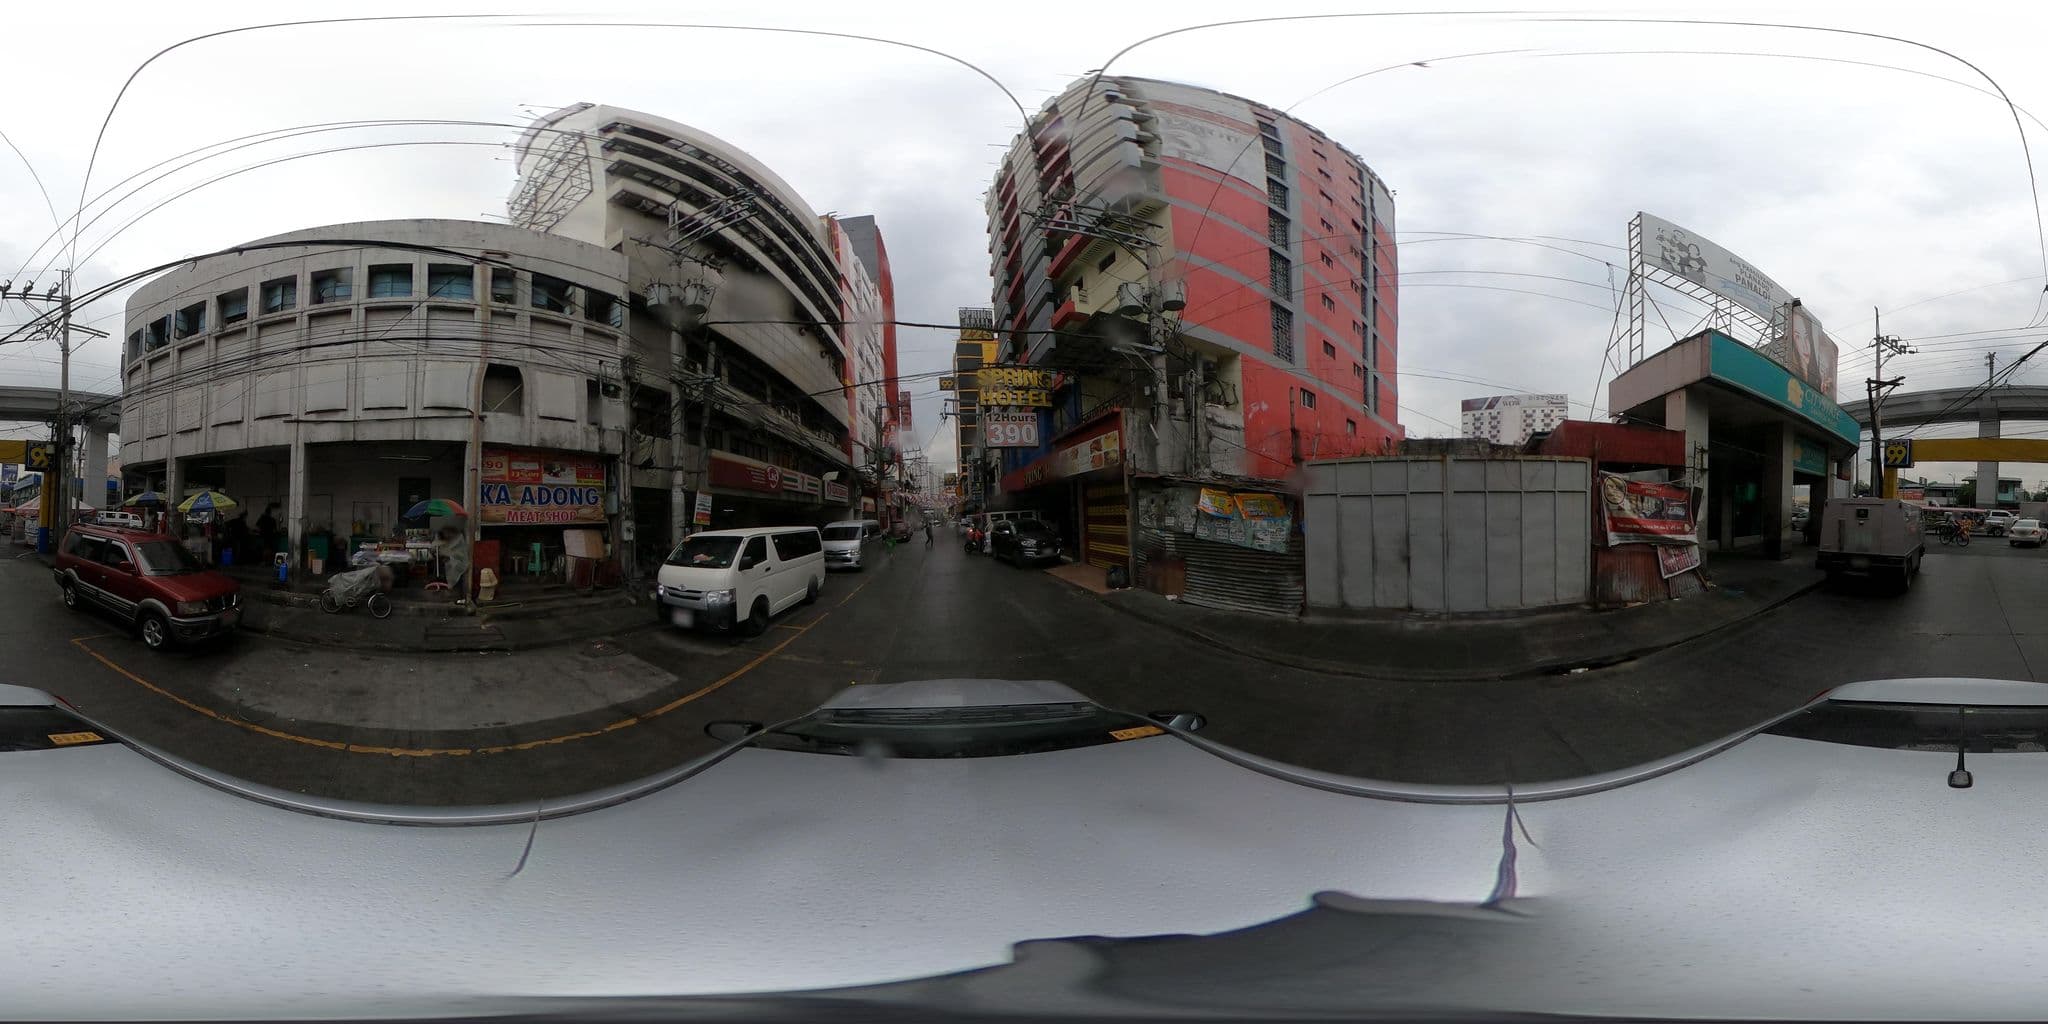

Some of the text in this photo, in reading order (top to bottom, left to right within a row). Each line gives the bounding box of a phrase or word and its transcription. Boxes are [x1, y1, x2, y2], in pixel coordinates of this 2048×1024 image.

[977, 369, 1051, 388] SPRING
[979, 390, 1050, 406] HOTEL
[989, 424, 1037, 444] 390
[1886, 446, 1907, 465] 99
[520, 485, 600, 506] ADONG
[507, 511, 577, 522] MEAT SHOP
